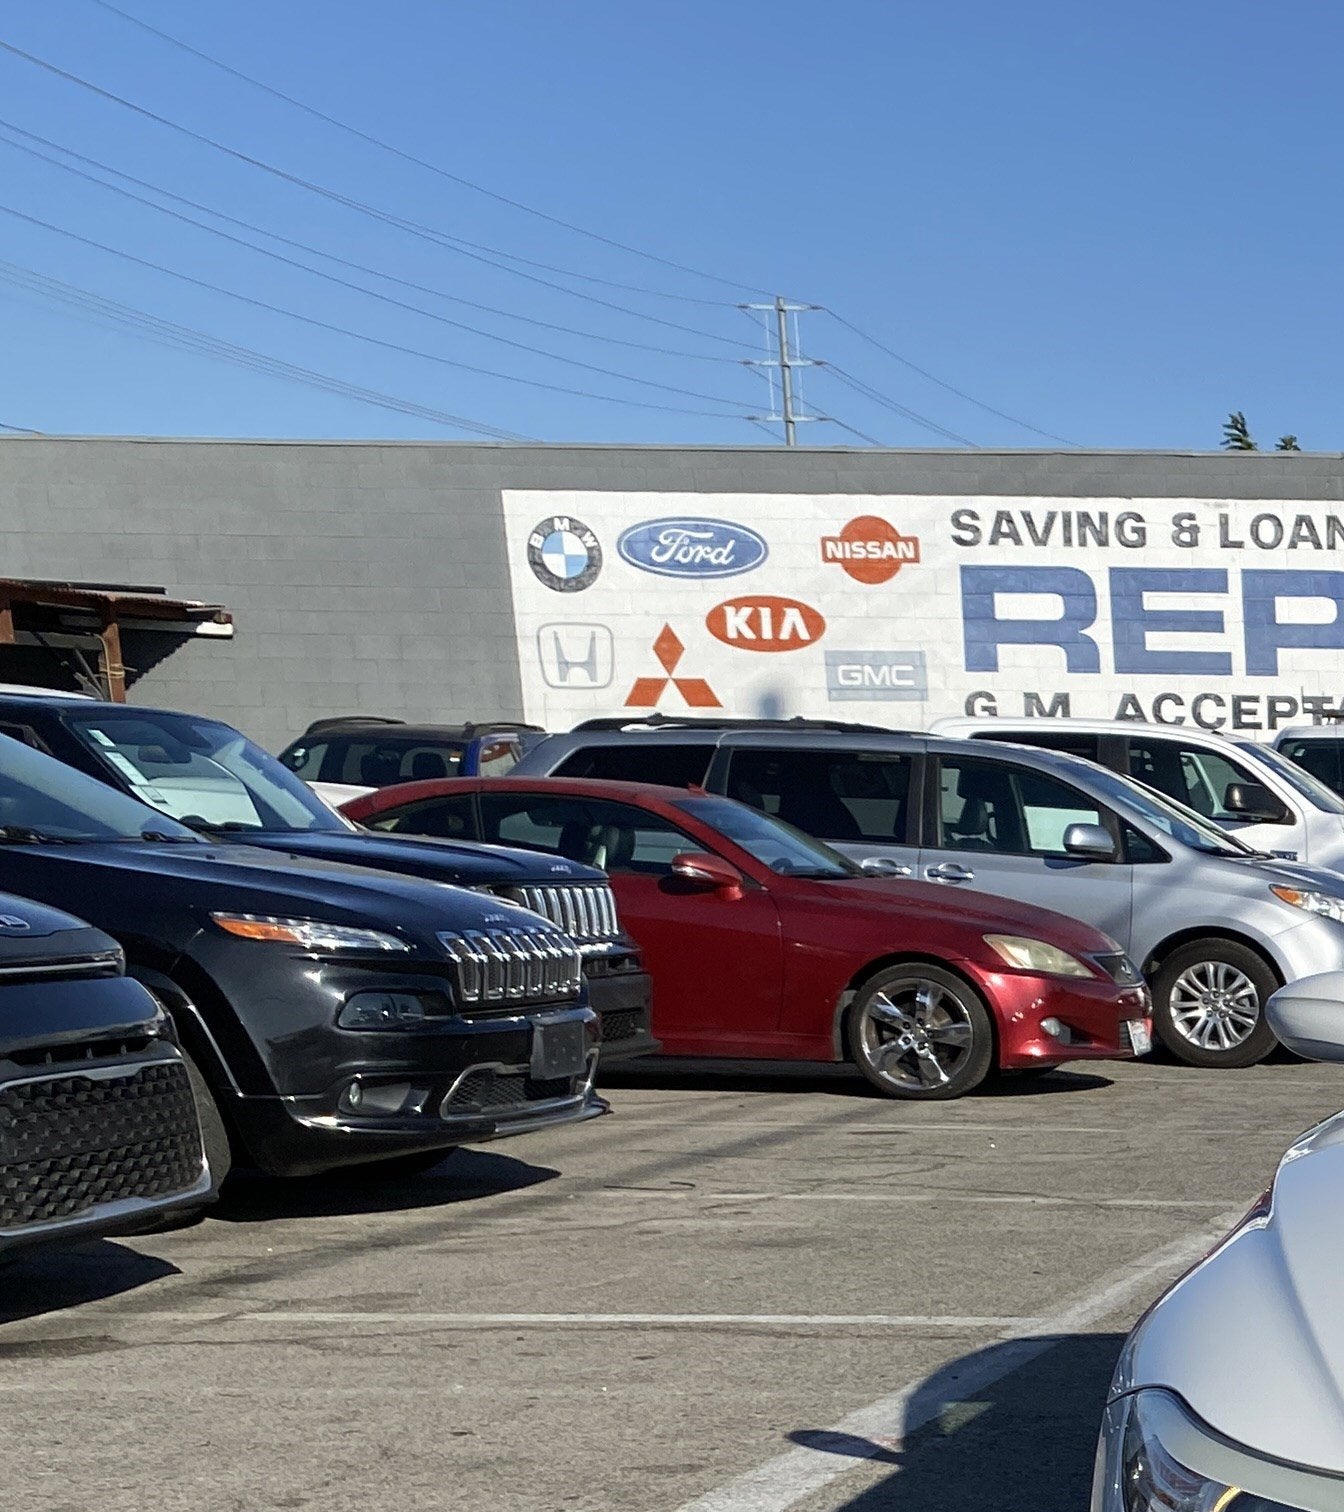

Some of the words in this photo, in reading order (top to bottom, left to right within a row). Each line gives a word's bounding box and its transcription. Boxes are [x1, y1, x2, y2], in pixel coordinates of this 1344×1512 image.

[529, 517, 598, 549] BMW
[951, 510, 1147, 548] SAVING
[1172, 513, 1201, 548] &
[650, 528, 735, 566] Ford
[826, 540, 915, 560] NISSAN
[723, 605, 811, 641] KIA
[837, 664, 916, 687] GMC
